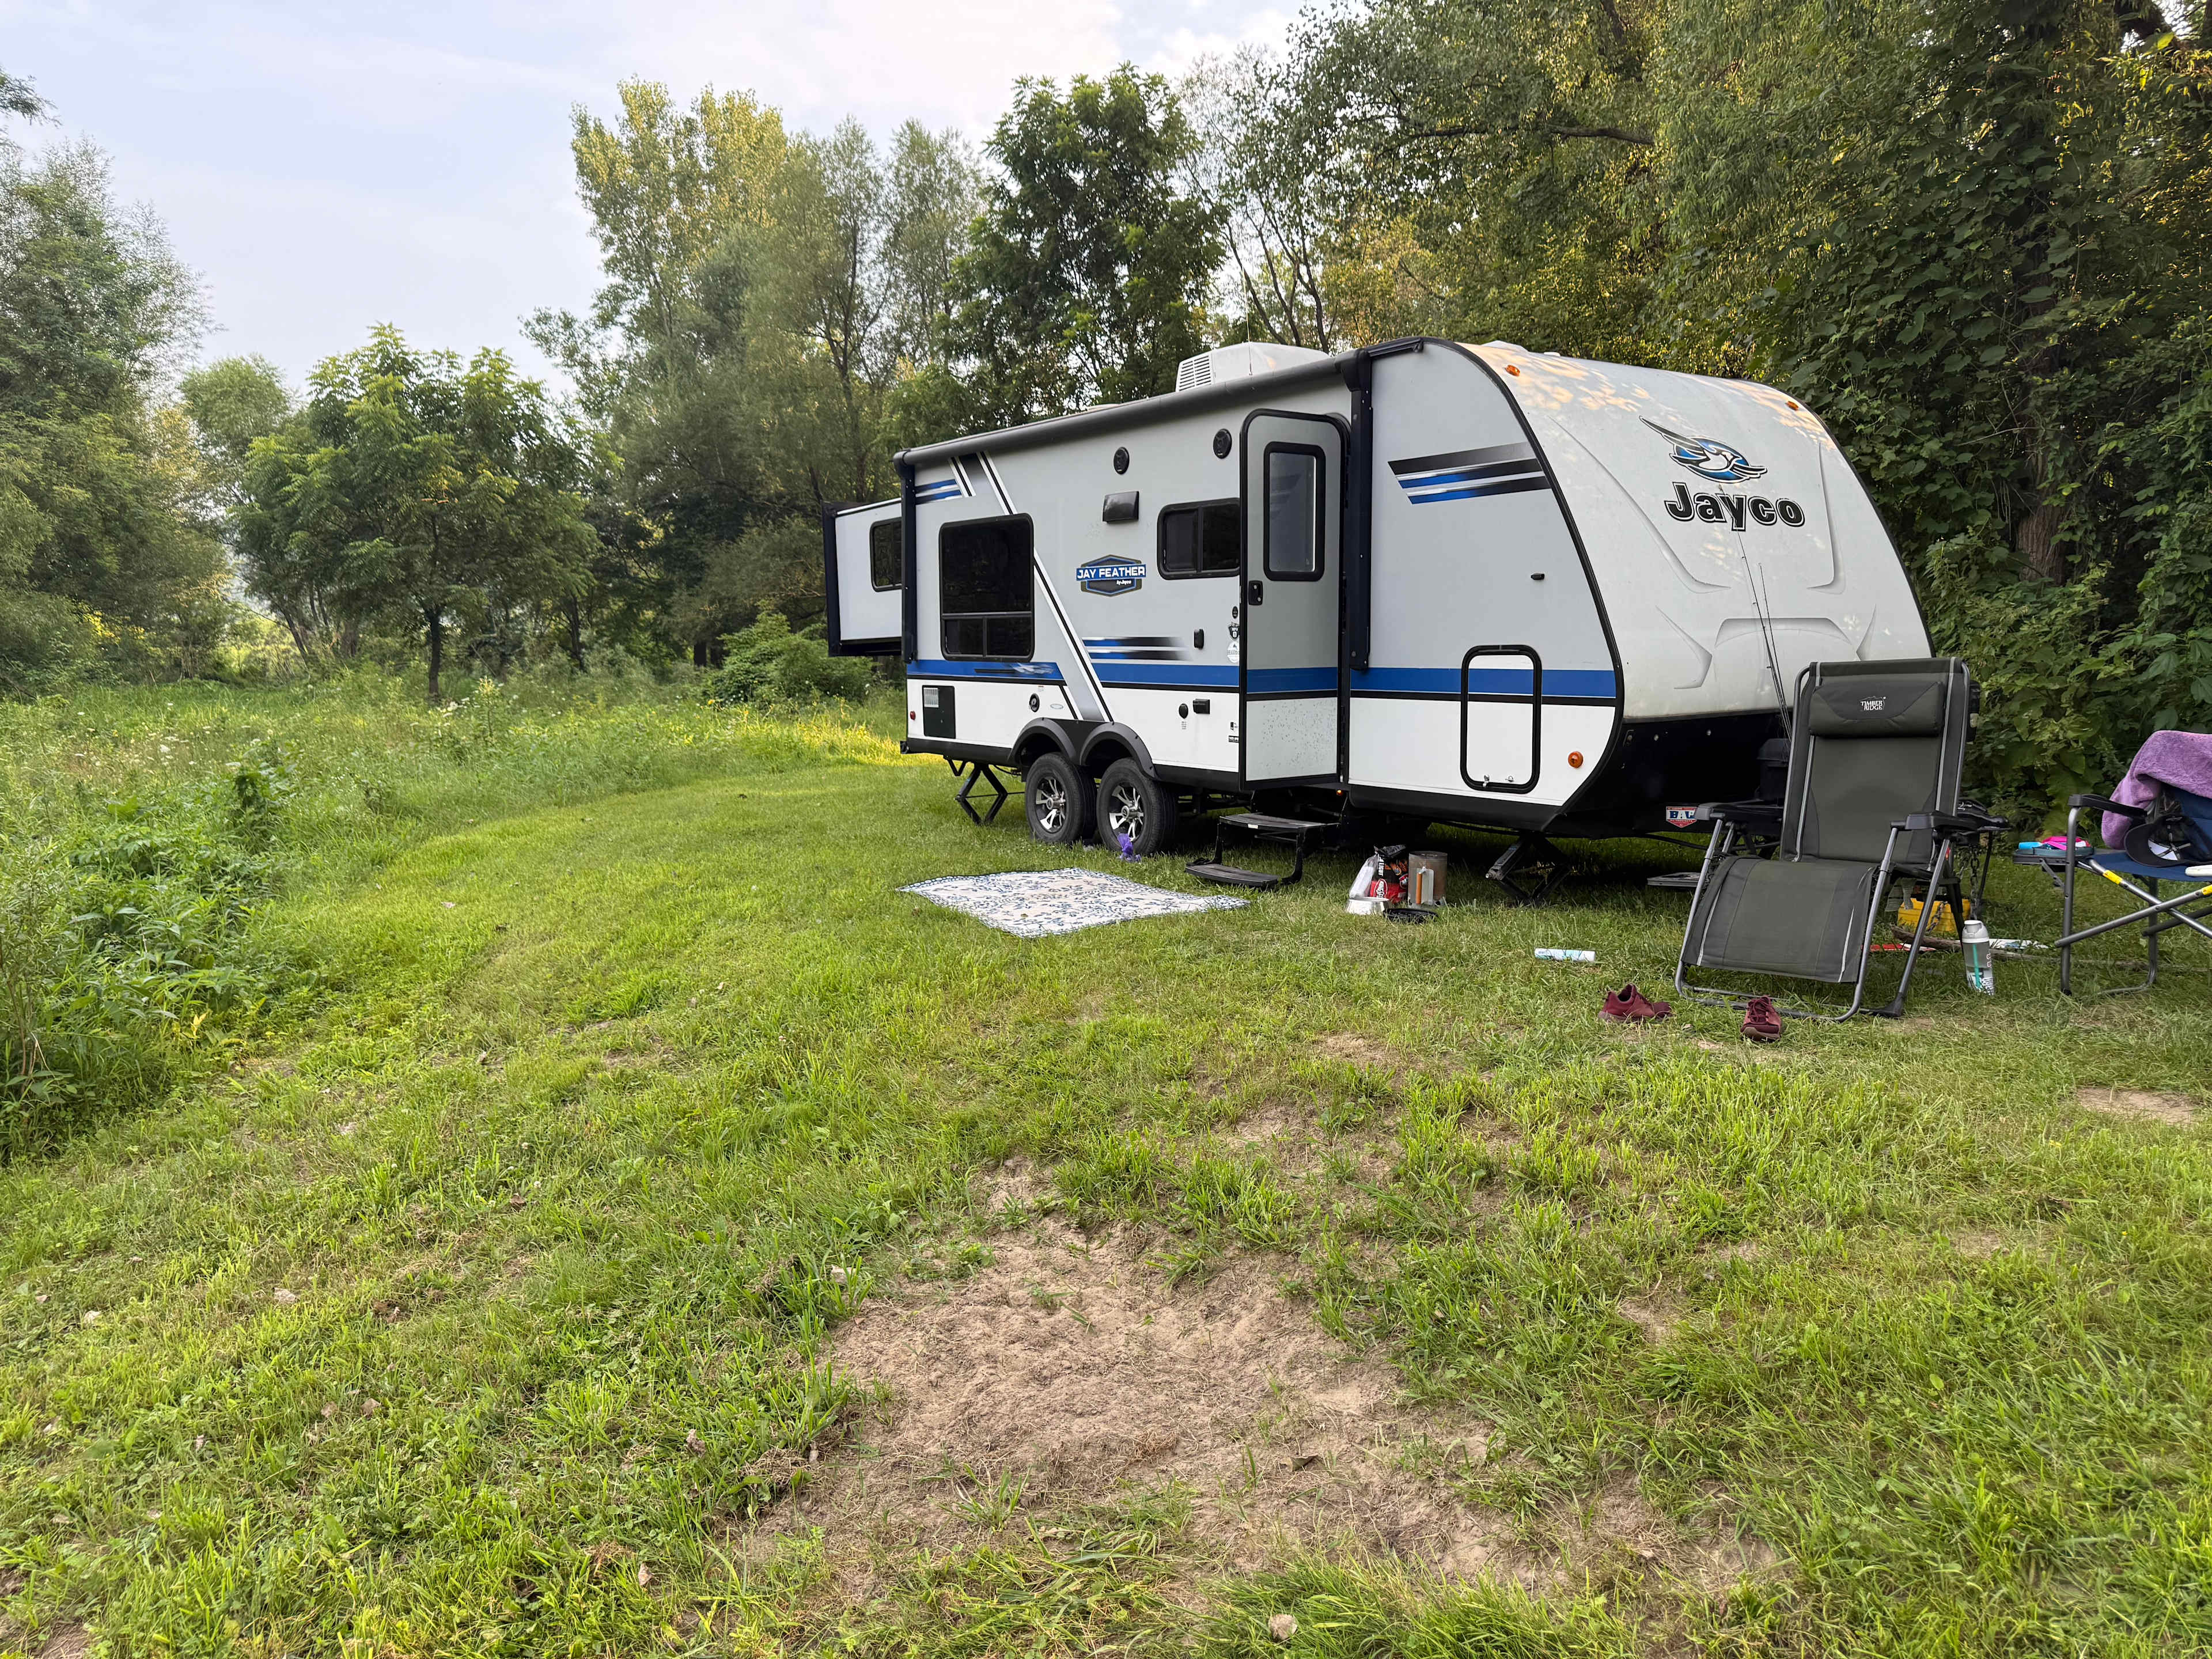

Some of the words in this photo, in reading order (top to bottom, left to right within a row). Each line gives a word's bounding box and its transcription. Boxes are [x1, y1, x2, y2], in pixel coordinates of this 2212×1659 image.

[1664, 482, 1806, 532] Jayco
[1077, 569, 1096, 579] JAY
[1099, 566, 1145, 578] FEATHER
